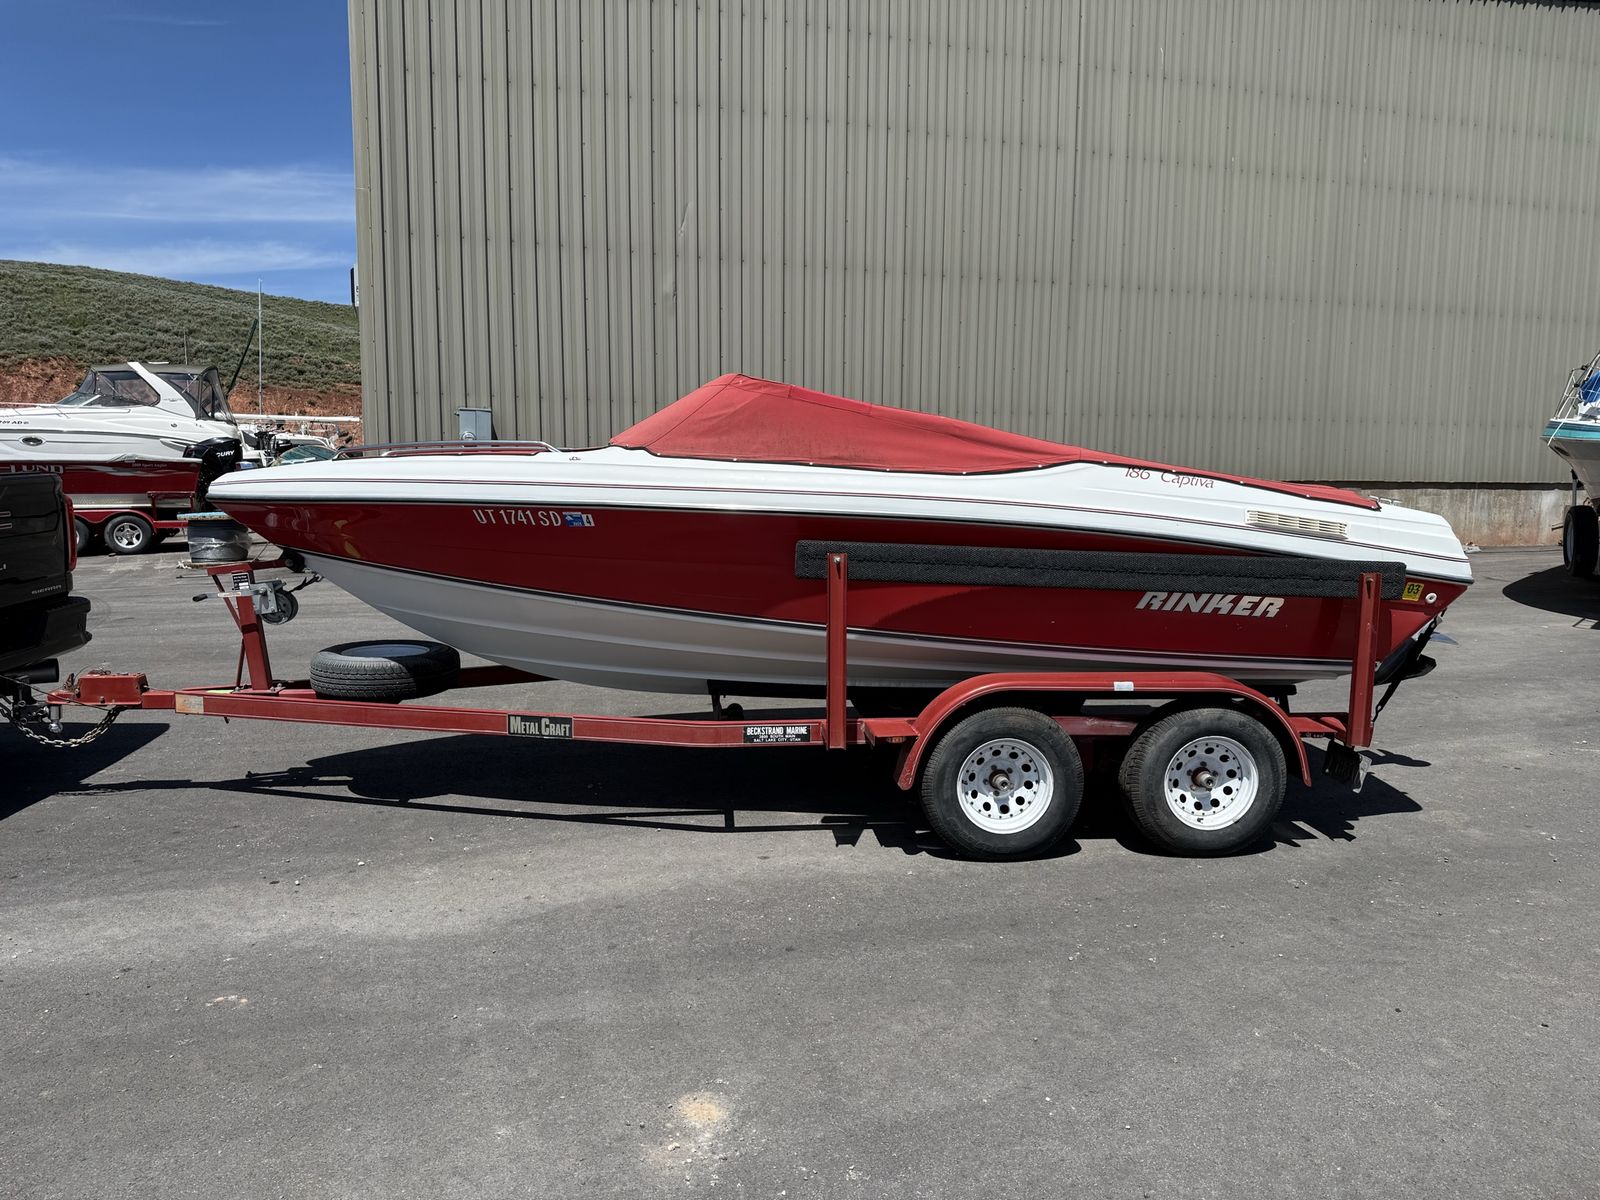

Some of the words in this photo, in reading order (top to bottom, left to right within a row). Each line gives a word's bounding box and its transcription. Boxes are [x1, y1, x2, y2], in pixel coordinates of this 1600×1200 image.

[10, 465, 64, 474] LUND
[1161, 470, 1214, 488] Captiva
[473, 509, 496, 524] UT
[499, 509, 536, 525] 1741
[538, 511, 561, 526] SD
[1407, 583, 1421, 595] 03
[1136, 591, 1285, 618] RINKER
[746, 727, 784, 735] BECKSTRAND
[786, 726, 808, 735] MARINE
